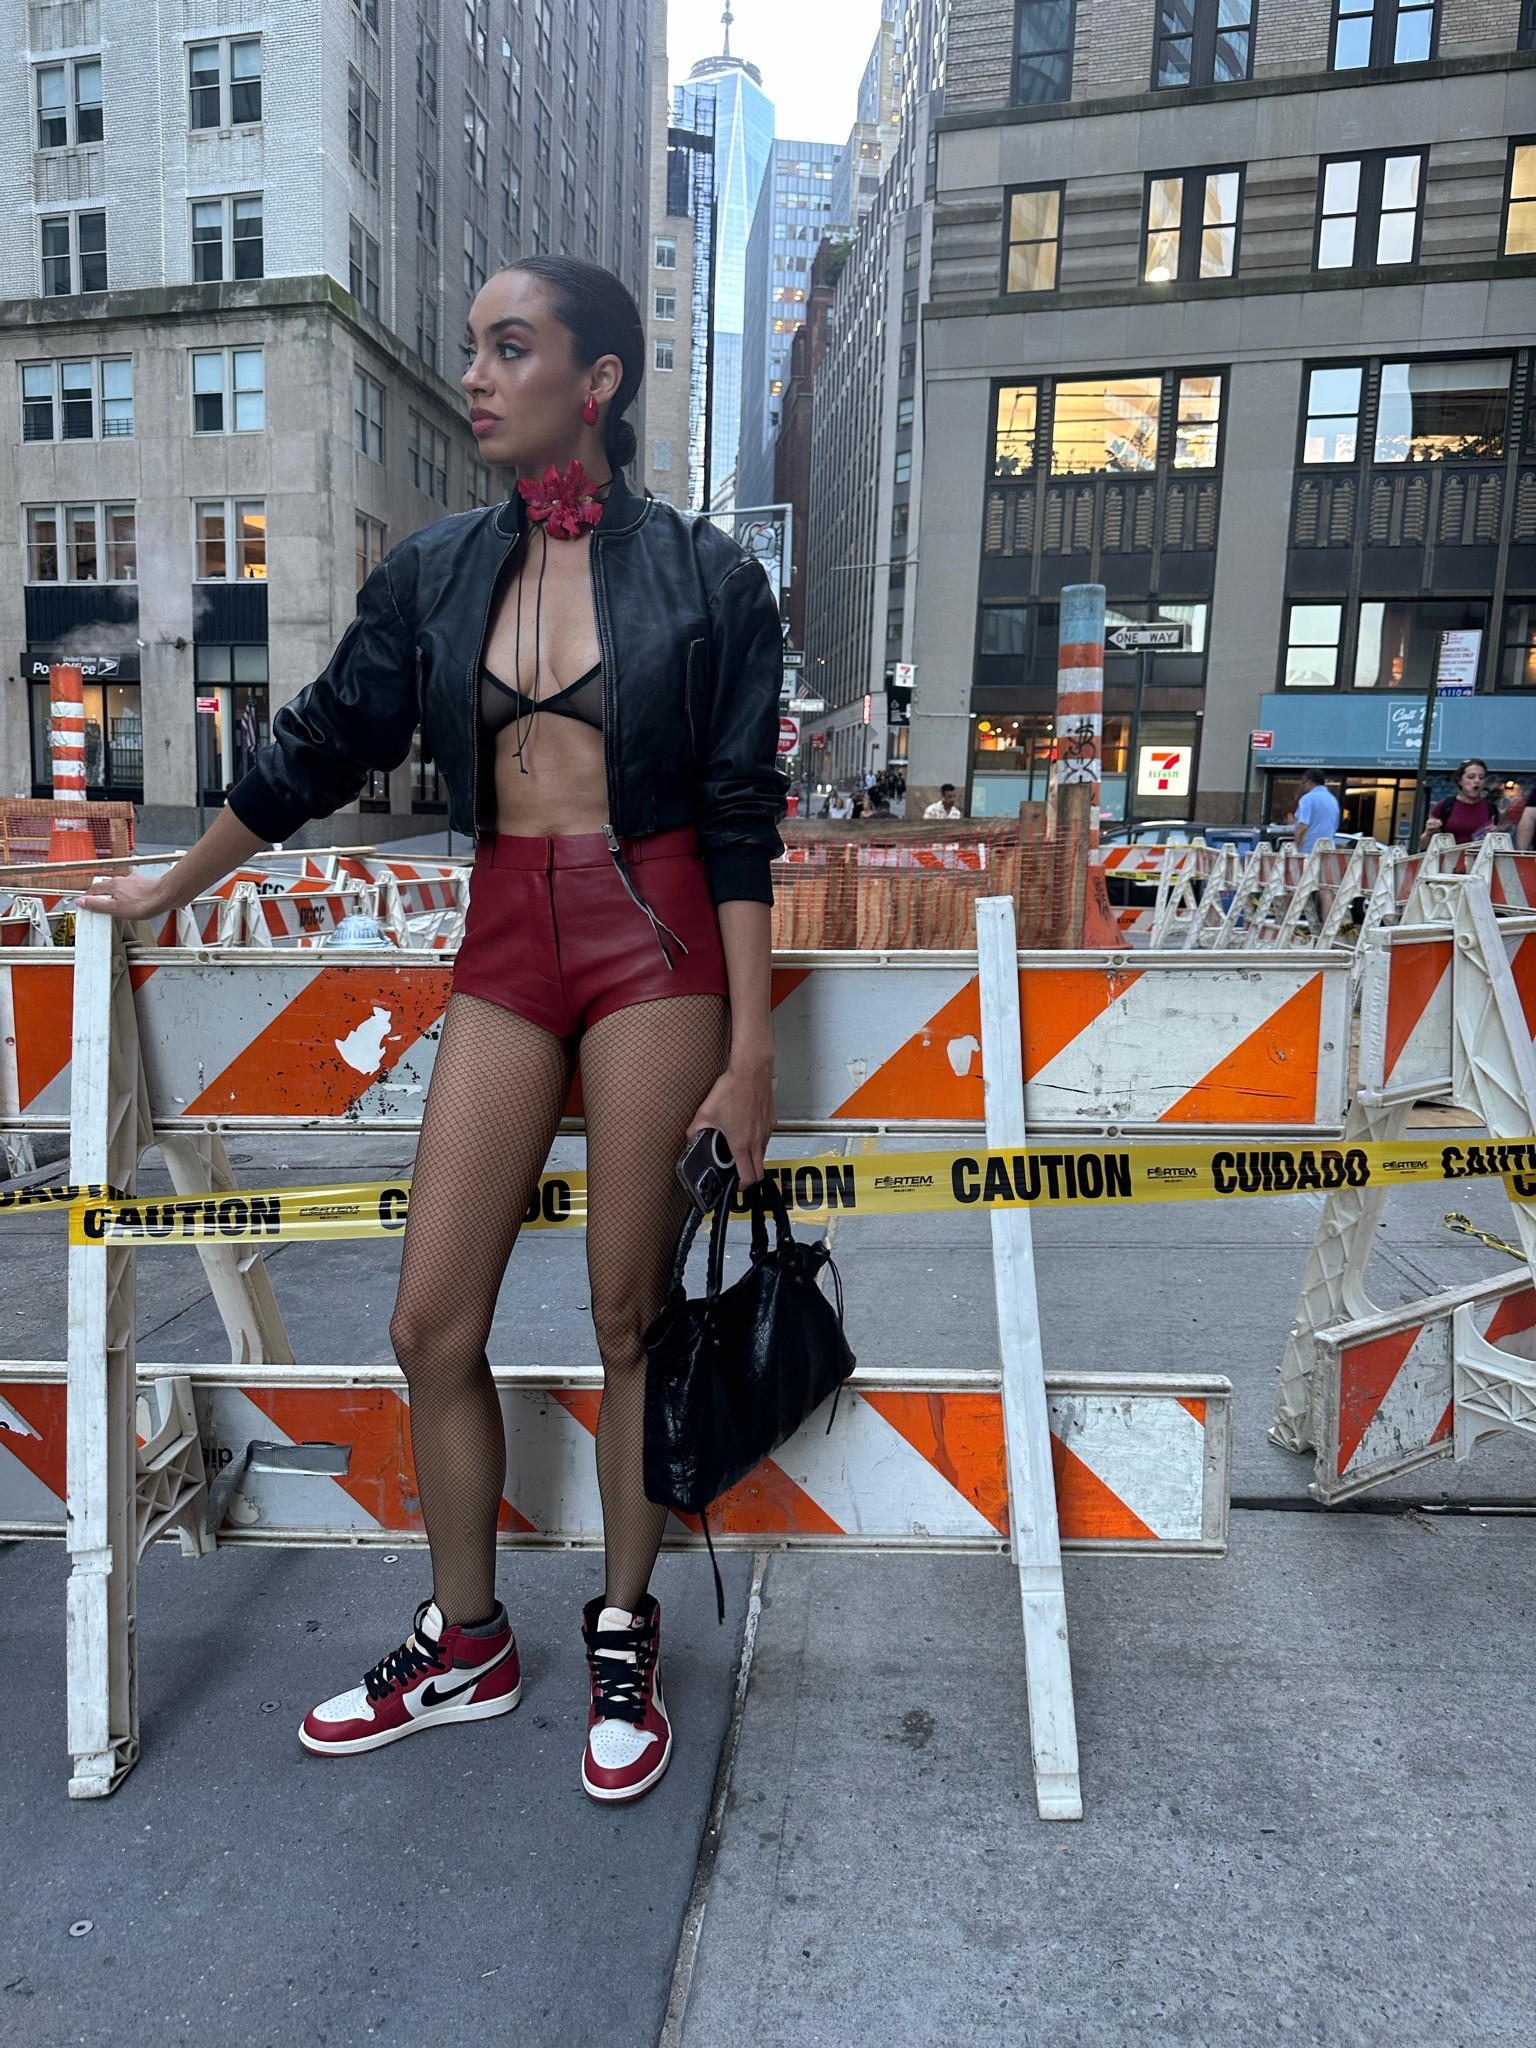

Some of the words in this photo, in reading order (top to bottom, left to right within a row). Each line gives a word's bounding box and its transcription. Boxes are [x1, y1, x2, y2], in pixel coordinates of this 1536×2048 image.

[1116, 633, 1139, 643] ONE
[1149, 632, 1174, 642] WAY
[1151, 753, 1180, 789] 7
[84, 1197, 281, 1239] CAUTION
[951, 1153, 1133, 1203] CAUTION
[1212, 1149, 1371, 1194] CUIDADO
